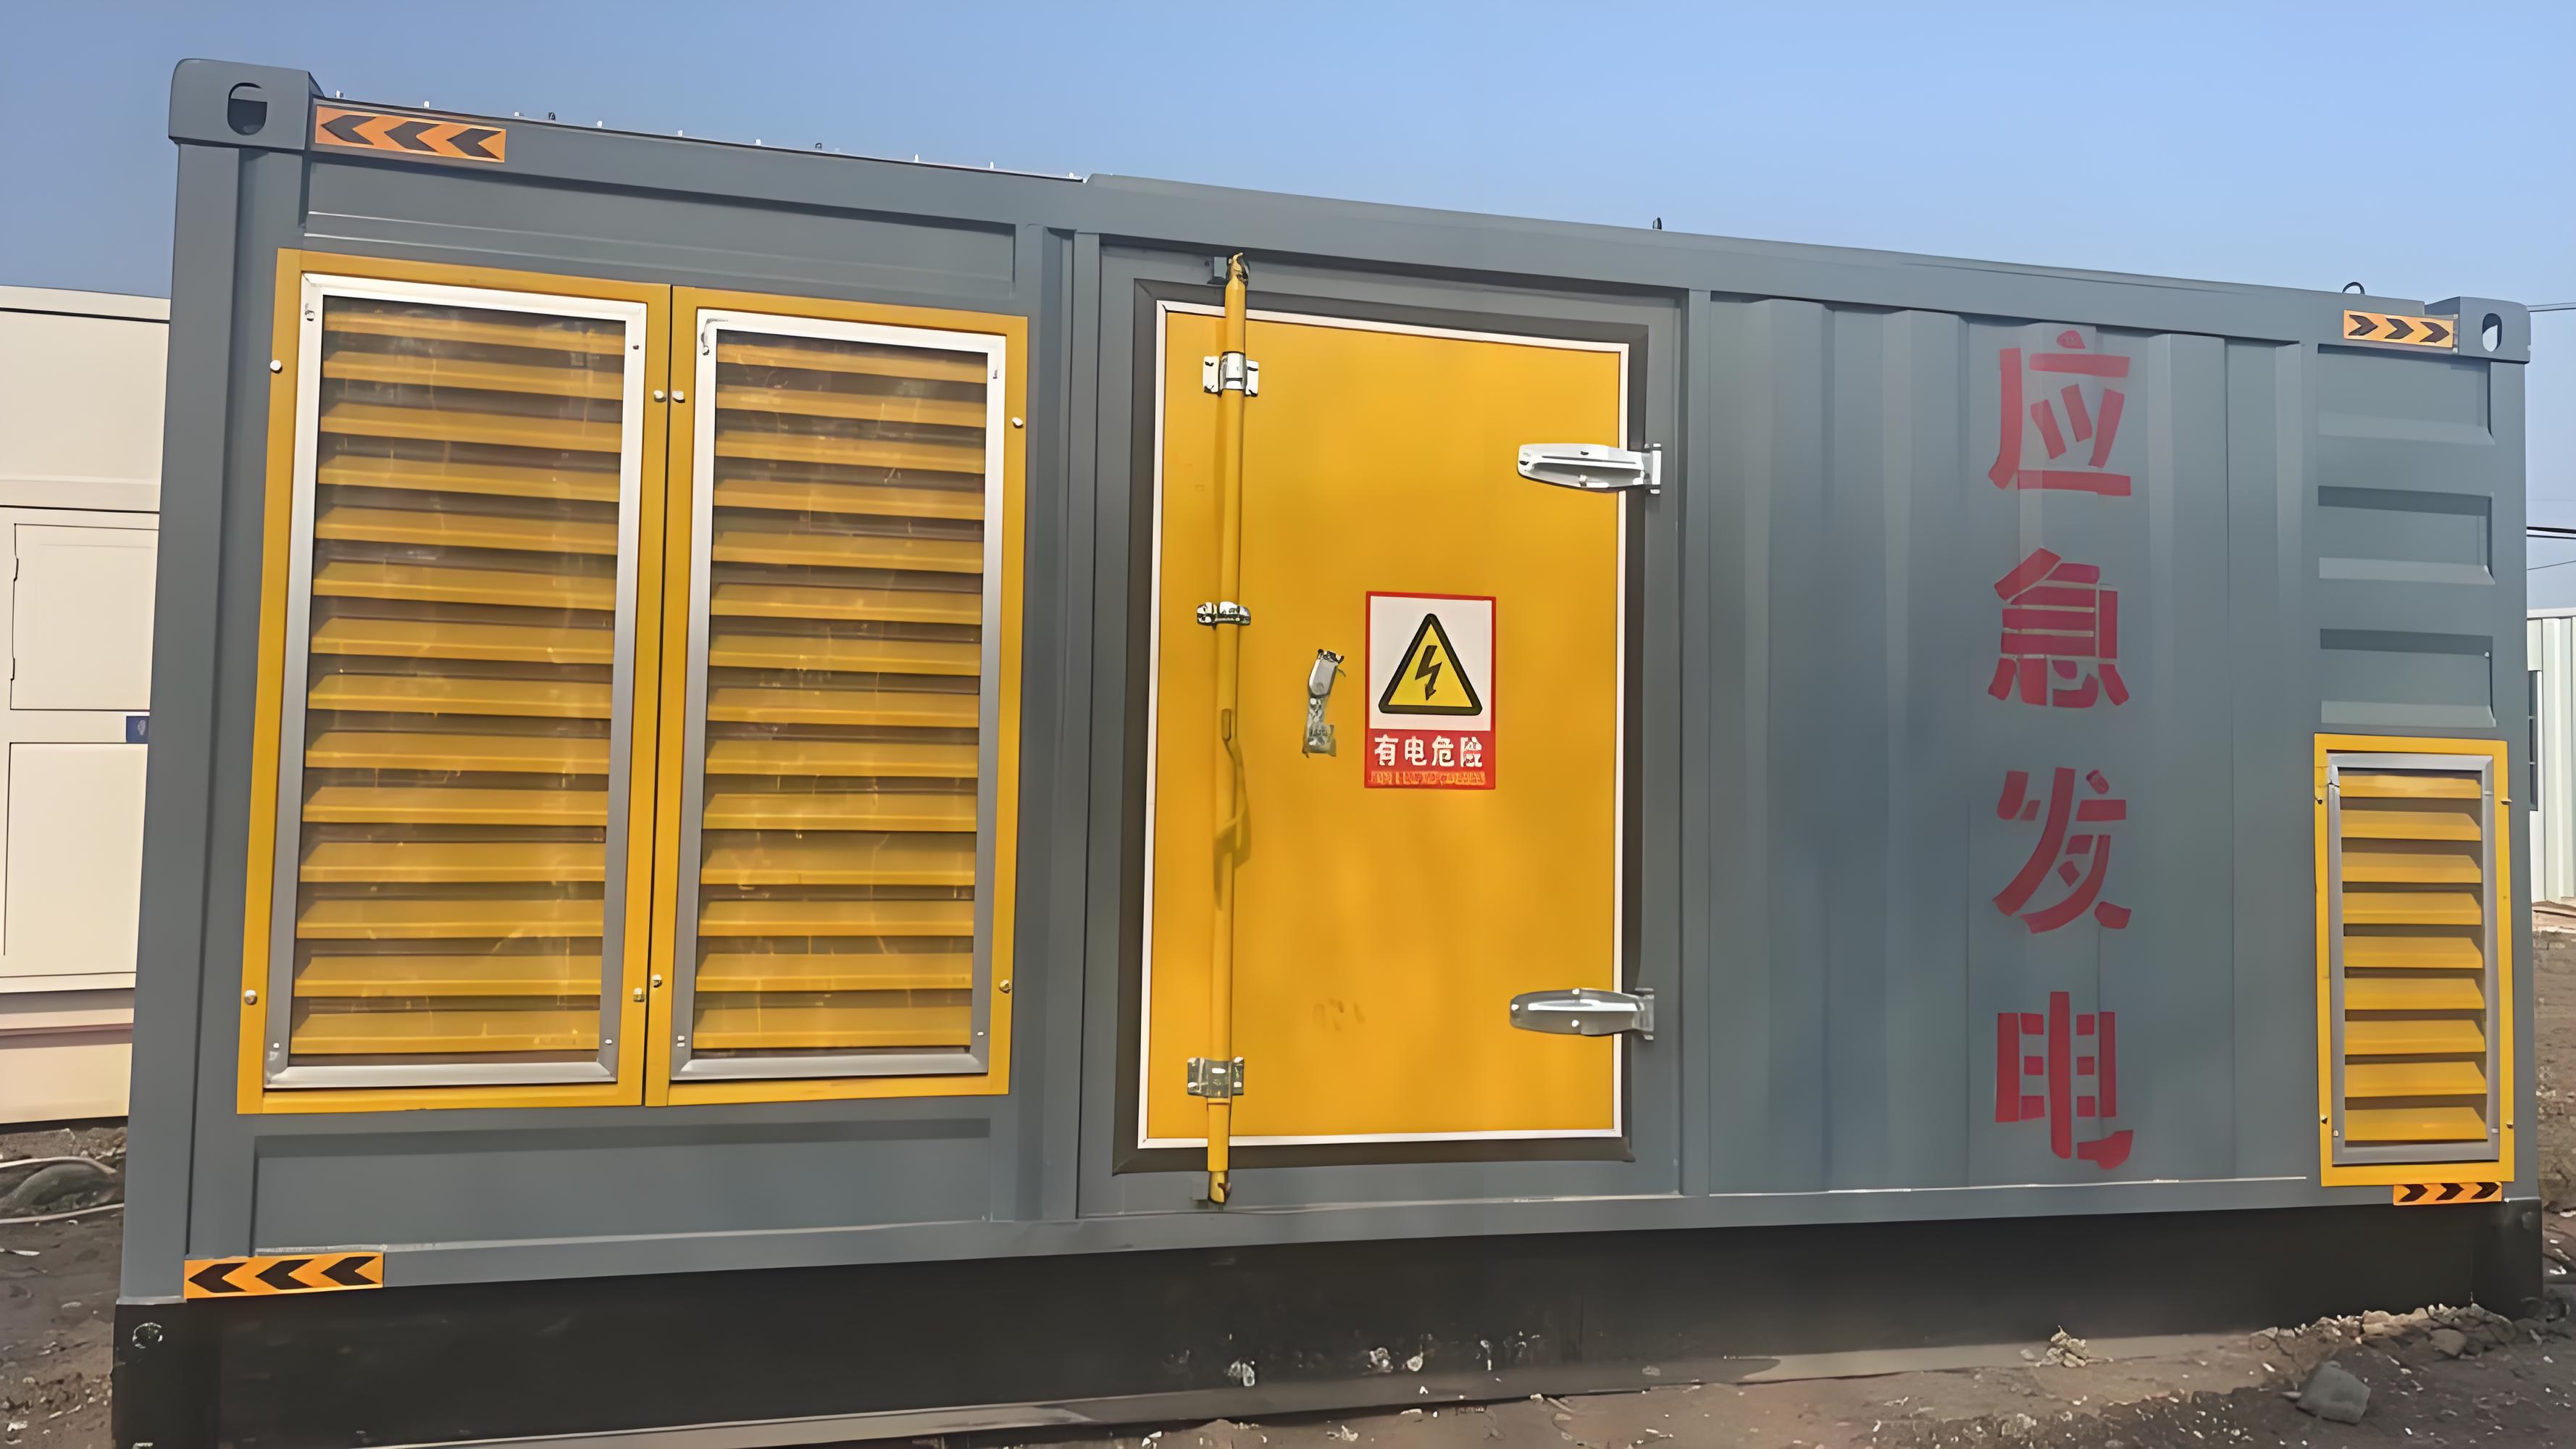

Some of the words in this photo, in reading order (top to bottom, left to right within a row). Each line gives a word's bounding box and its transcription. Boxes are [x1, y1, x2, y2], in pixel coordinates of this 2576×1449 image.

[1373, 734, 1484, 768] 有电危险
[1988, 330, 2133, 1170] 应急发电
